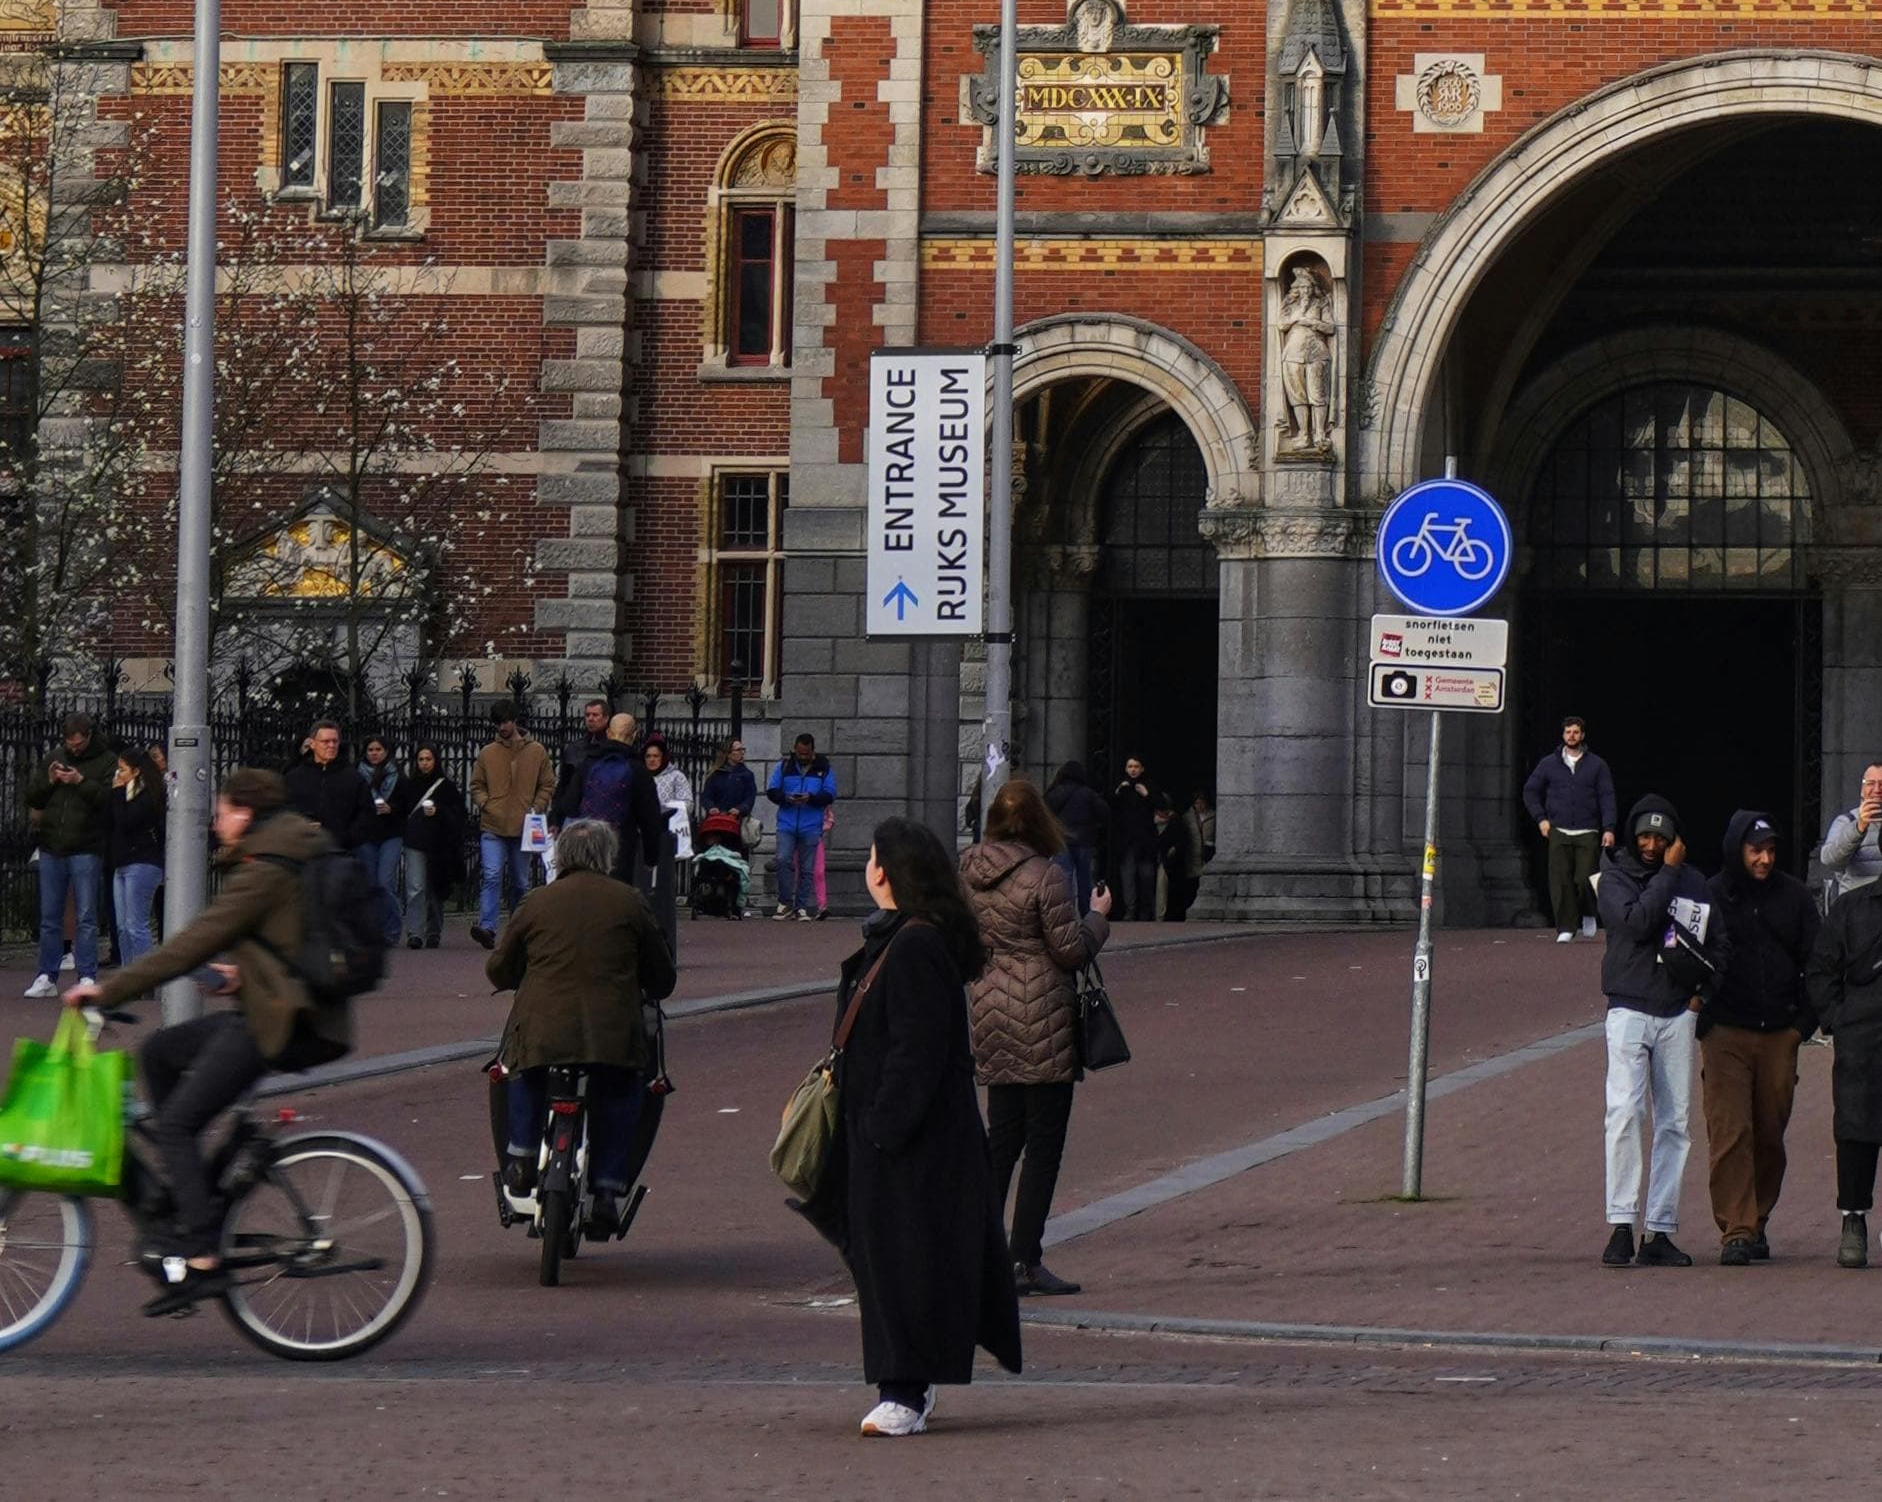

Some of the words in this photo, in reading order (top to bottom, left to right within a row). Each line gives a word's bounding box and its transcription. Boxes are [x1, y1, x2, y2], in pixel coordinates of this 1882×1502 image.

[885, 368, 916, 551] ENTRANCE
[938, 367, 969, 518] MUSEUM
[937, 528, 968, 620] RIJKS
[1405, 620, 1475, 631] snorfietsen
[1428, 635, 1452, 644] niet
[1405, 649, 1472, 660] toegestaan
